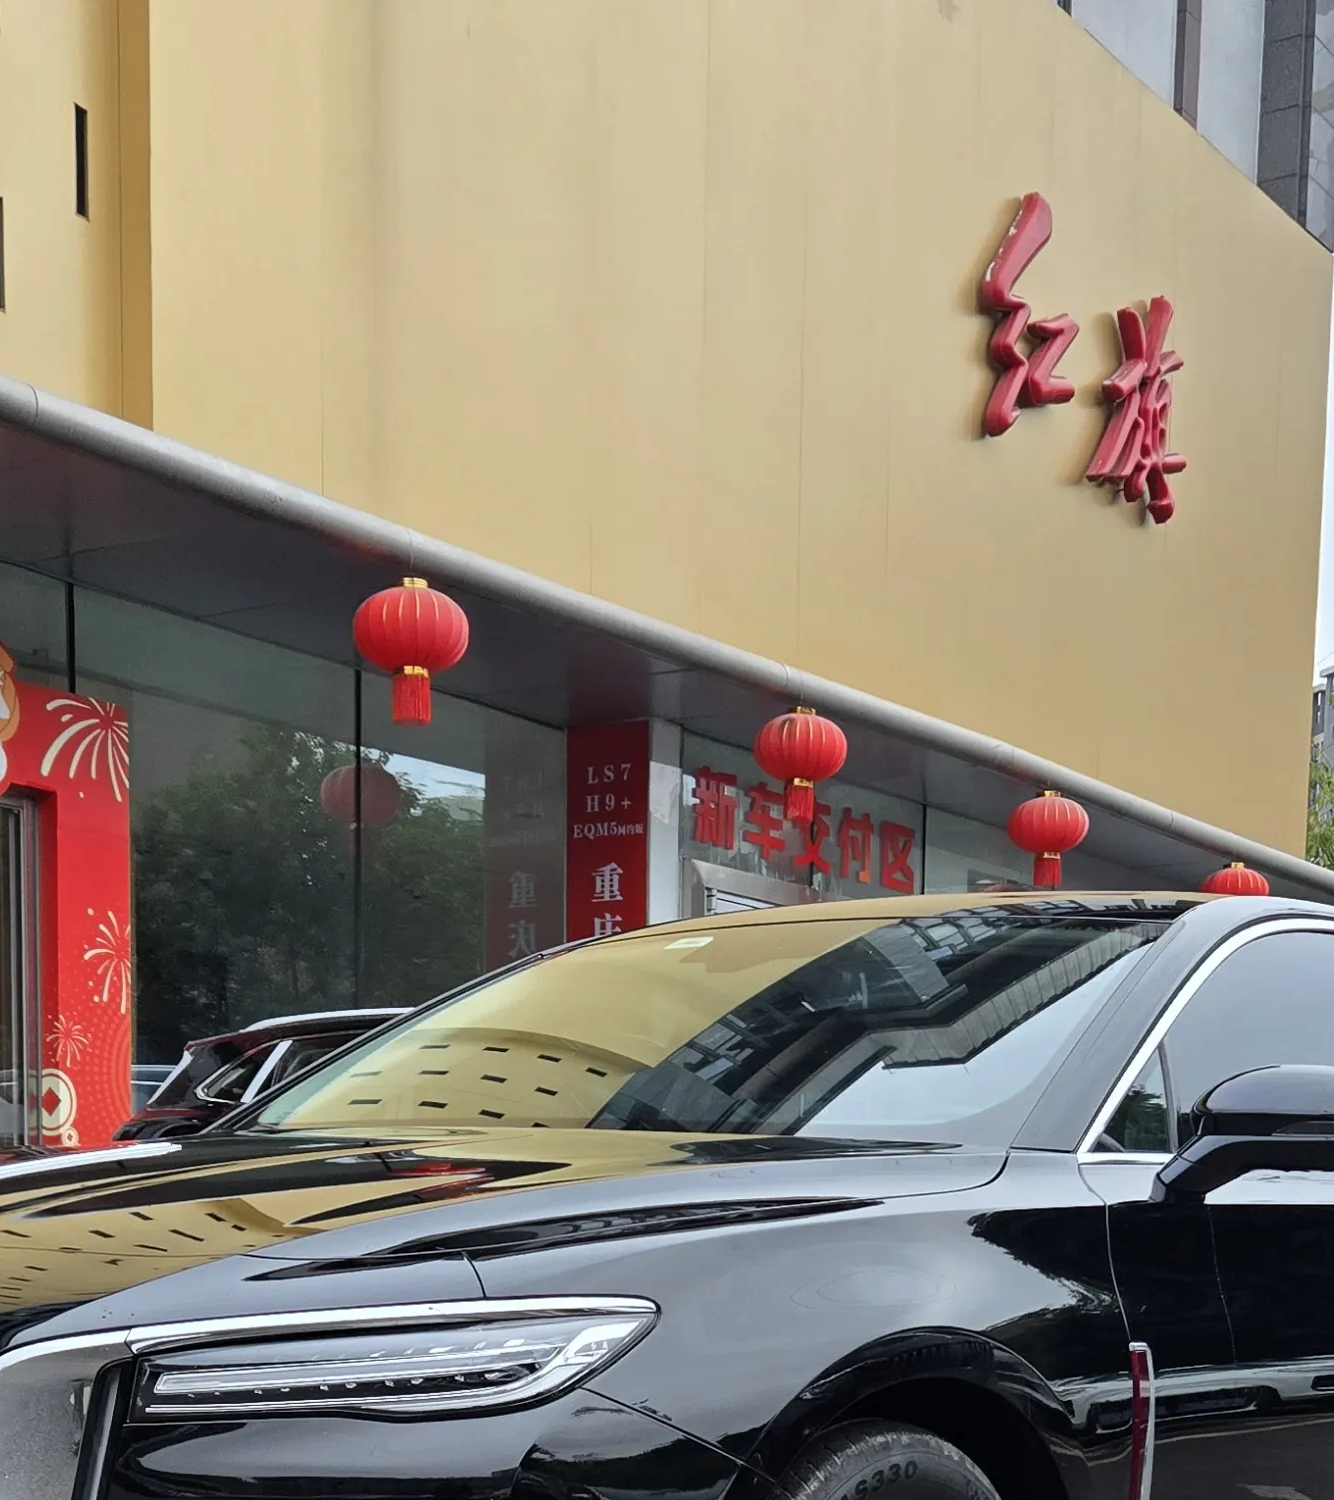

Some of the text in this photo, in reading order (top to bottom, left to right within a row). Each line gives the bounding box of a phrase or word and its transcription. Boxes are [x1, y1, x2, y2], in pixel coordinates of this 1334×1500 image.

[978, 191, 1187, 524] 红旗
[694, 766, 915, 894] 新车交付区
